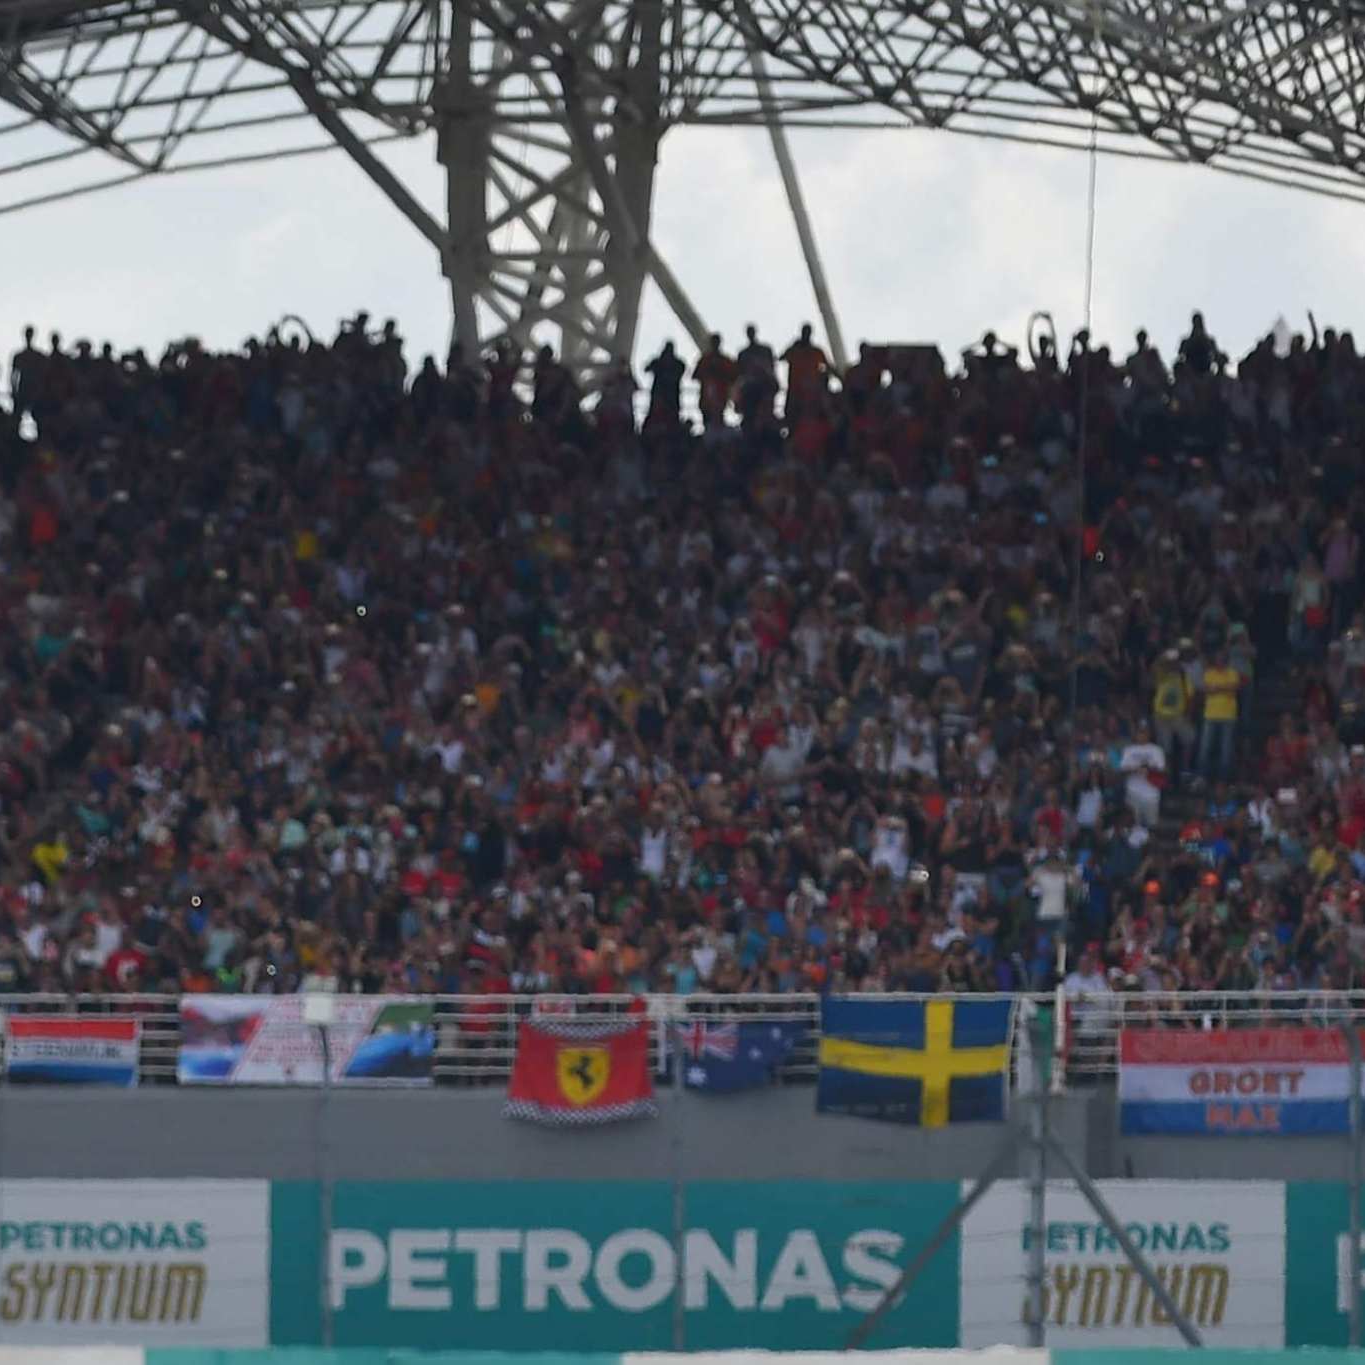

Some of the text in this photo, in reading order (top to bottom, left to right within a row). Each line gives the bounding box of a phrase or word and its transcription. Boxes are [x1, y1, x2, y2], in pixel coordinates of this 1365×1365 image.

[0, 1221, 208, 1251] PETRONAS
[1022, 1222, 1231, 1252] PETRONAS
[330, 1228, 905, 1312] PETRONAS
